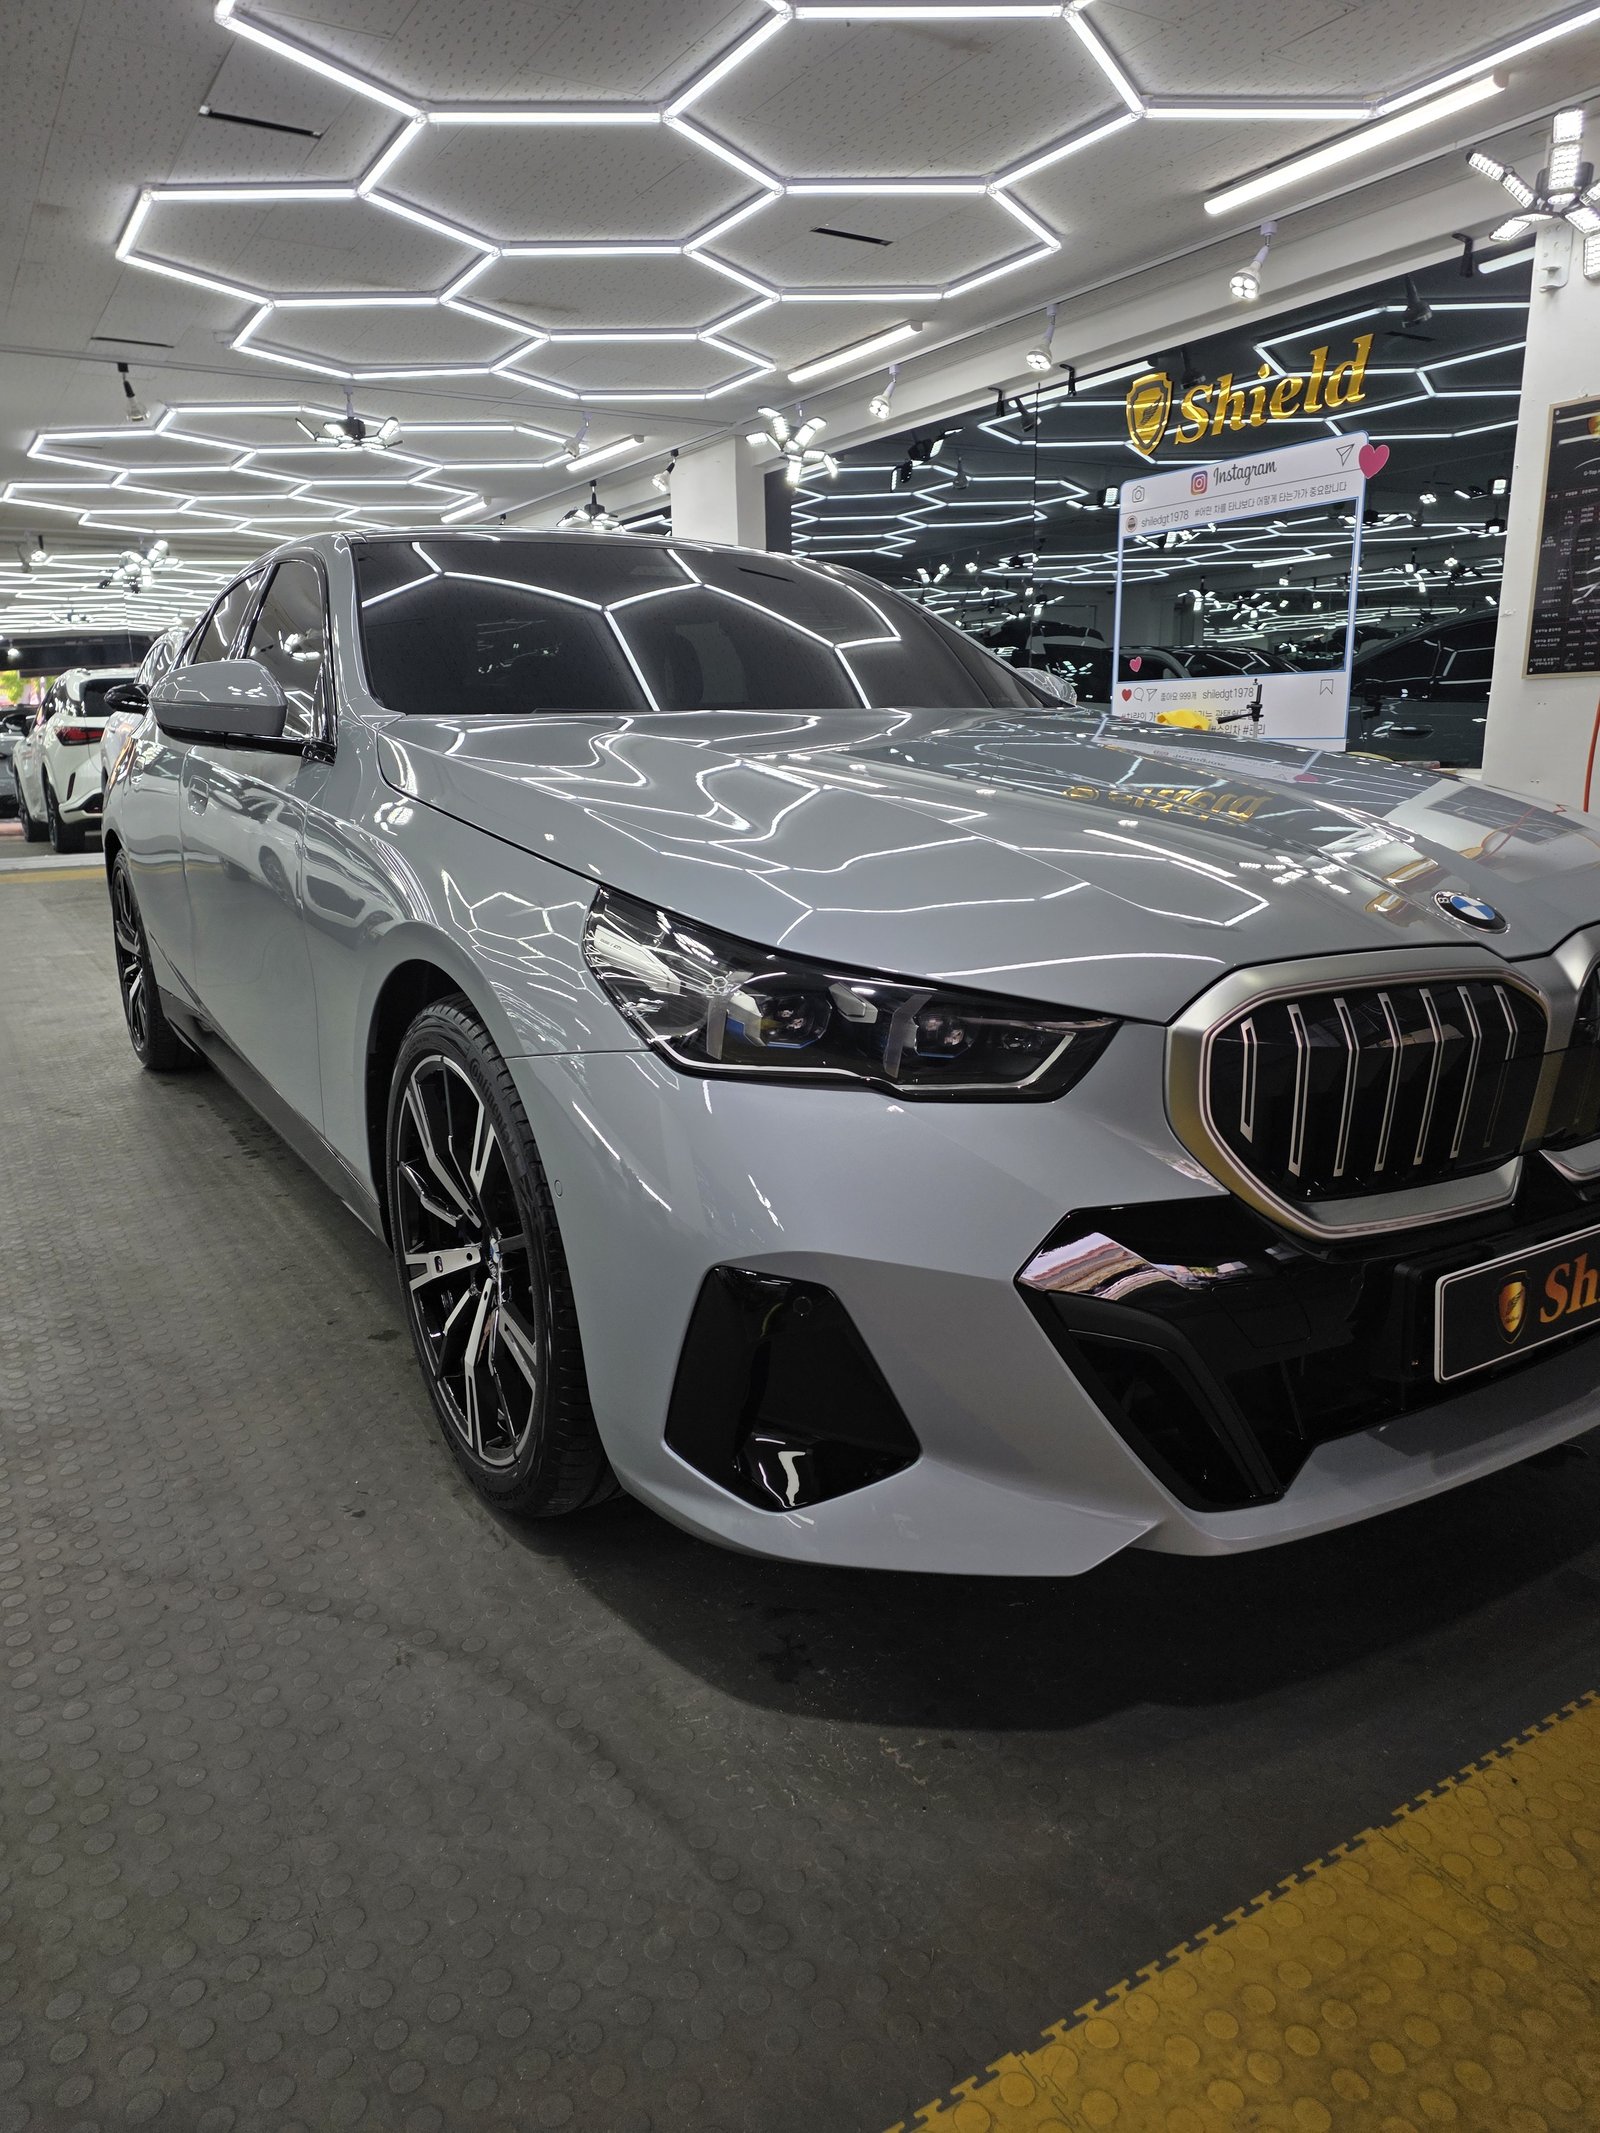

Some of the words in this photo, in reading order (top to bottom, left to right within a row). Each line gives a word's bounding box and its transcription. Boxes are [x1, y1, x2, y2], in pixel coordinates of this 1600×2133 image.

[1174, 333, 1374, 445] Shield
[1213, 460, 1277, 486] Instagram
[1141, 509, 1189, 527] shiledgt1978
[1309, 481, 1347, 498] 중요합니다
[1179, 691, 1197, 701] 999개
[1202, 687, 1254, 701] shiledgt1978
[1539, 1251, 1600, 1323] Sh
